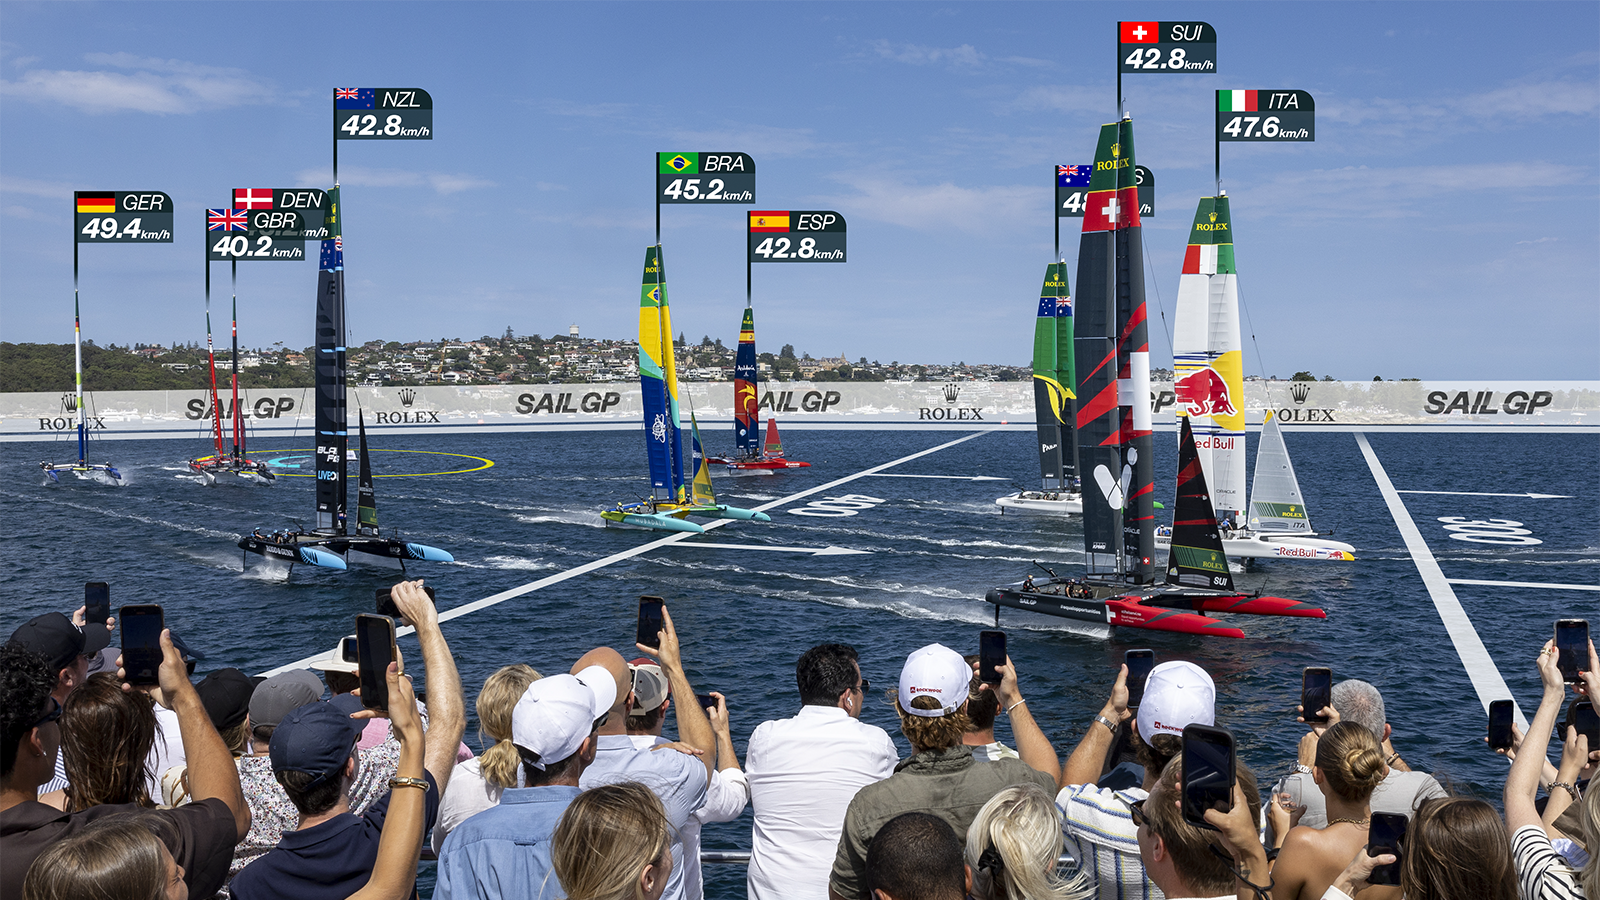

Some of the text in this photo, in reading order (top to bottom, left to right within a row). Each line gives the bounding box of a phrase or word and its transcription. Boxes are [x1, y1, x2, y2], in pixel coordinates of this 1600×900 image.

[1097, 158, 1130, 171] ROLEX
[1196, 223, 1228, 231] ROLEX
[1194, 437, 1236, 450] ed Bull
[1279, 547, 1317, 558] Red Bull
[1202, 561, 1224, 570] ROLEX
[1213, 576, 1228, 586] SUI
[1161, 724, 1184, 732] ROCKWO
